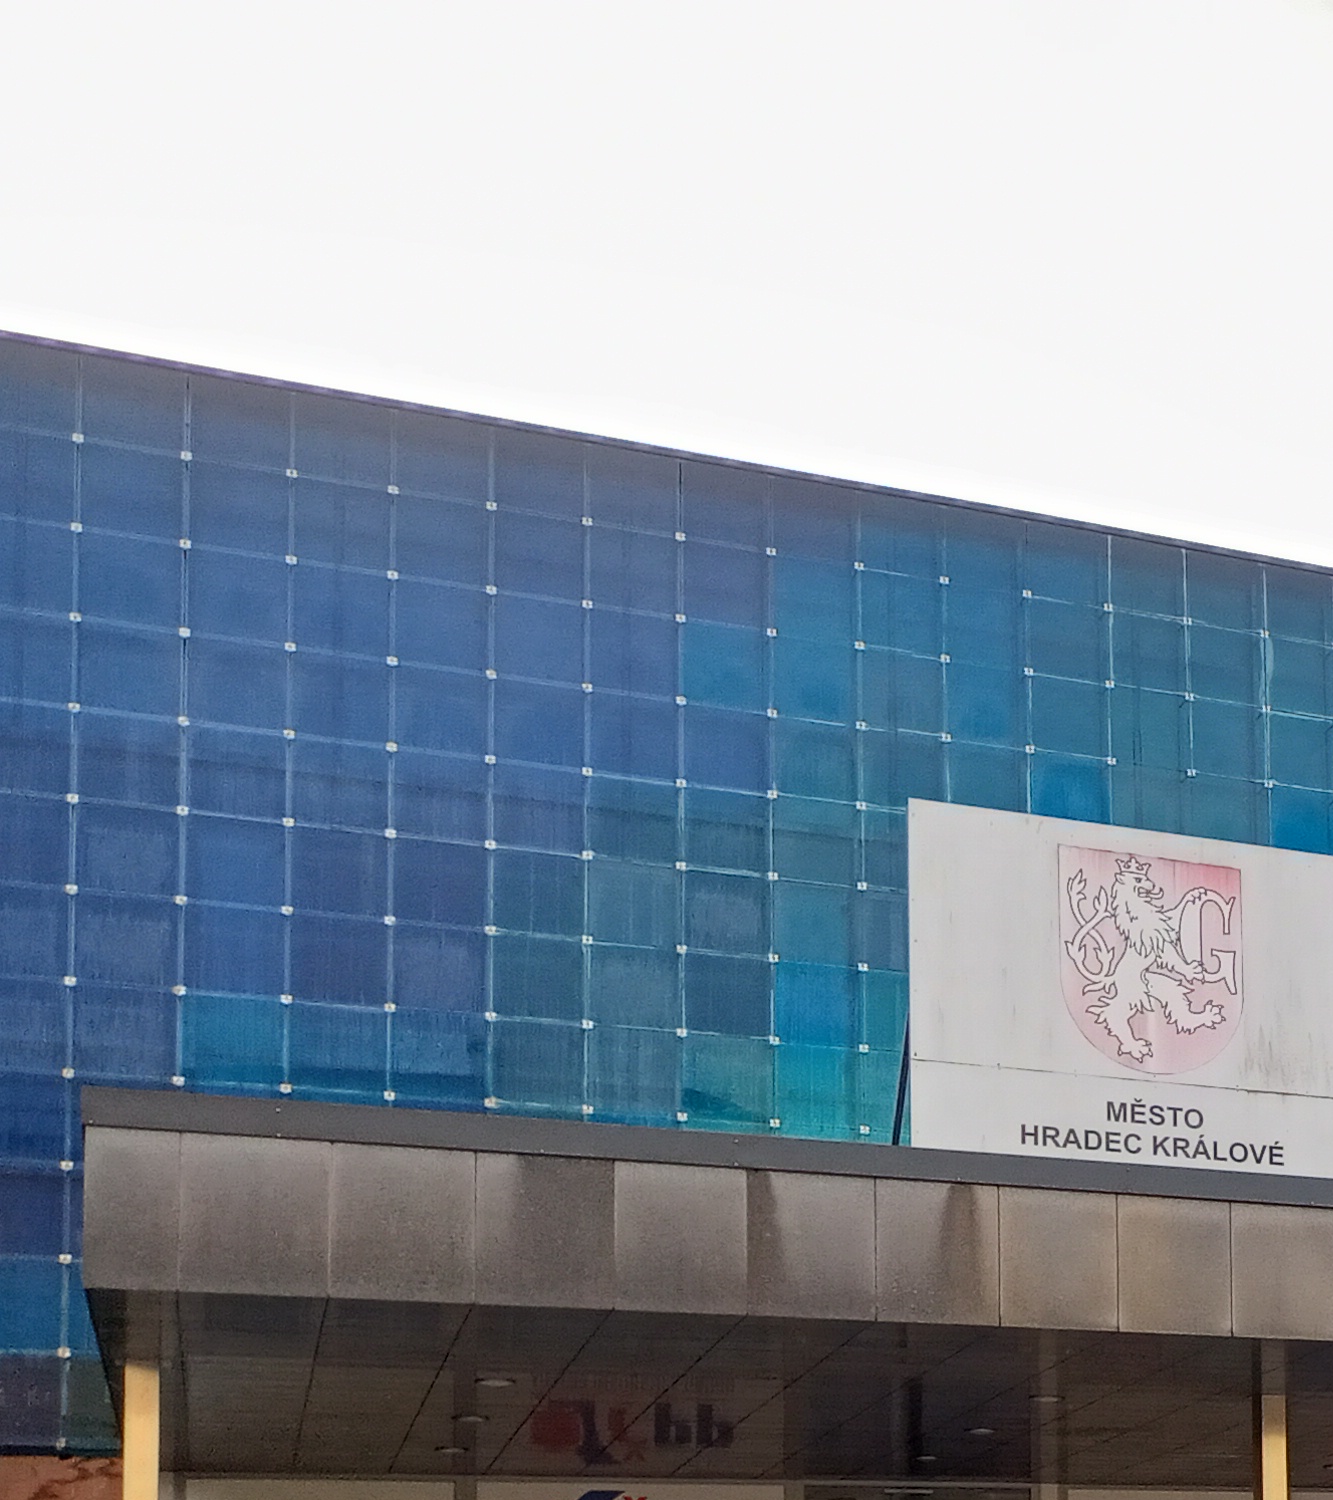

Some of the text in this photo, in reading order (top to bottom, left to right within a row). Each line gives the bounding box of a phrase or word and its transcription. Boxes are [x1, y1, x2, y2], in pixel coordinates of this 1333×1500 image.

[1105, 1097, 1205, 1129] MĚSTO
[1019, 1123, 1286, 1167] HRADEC KRÁLOVÉ
